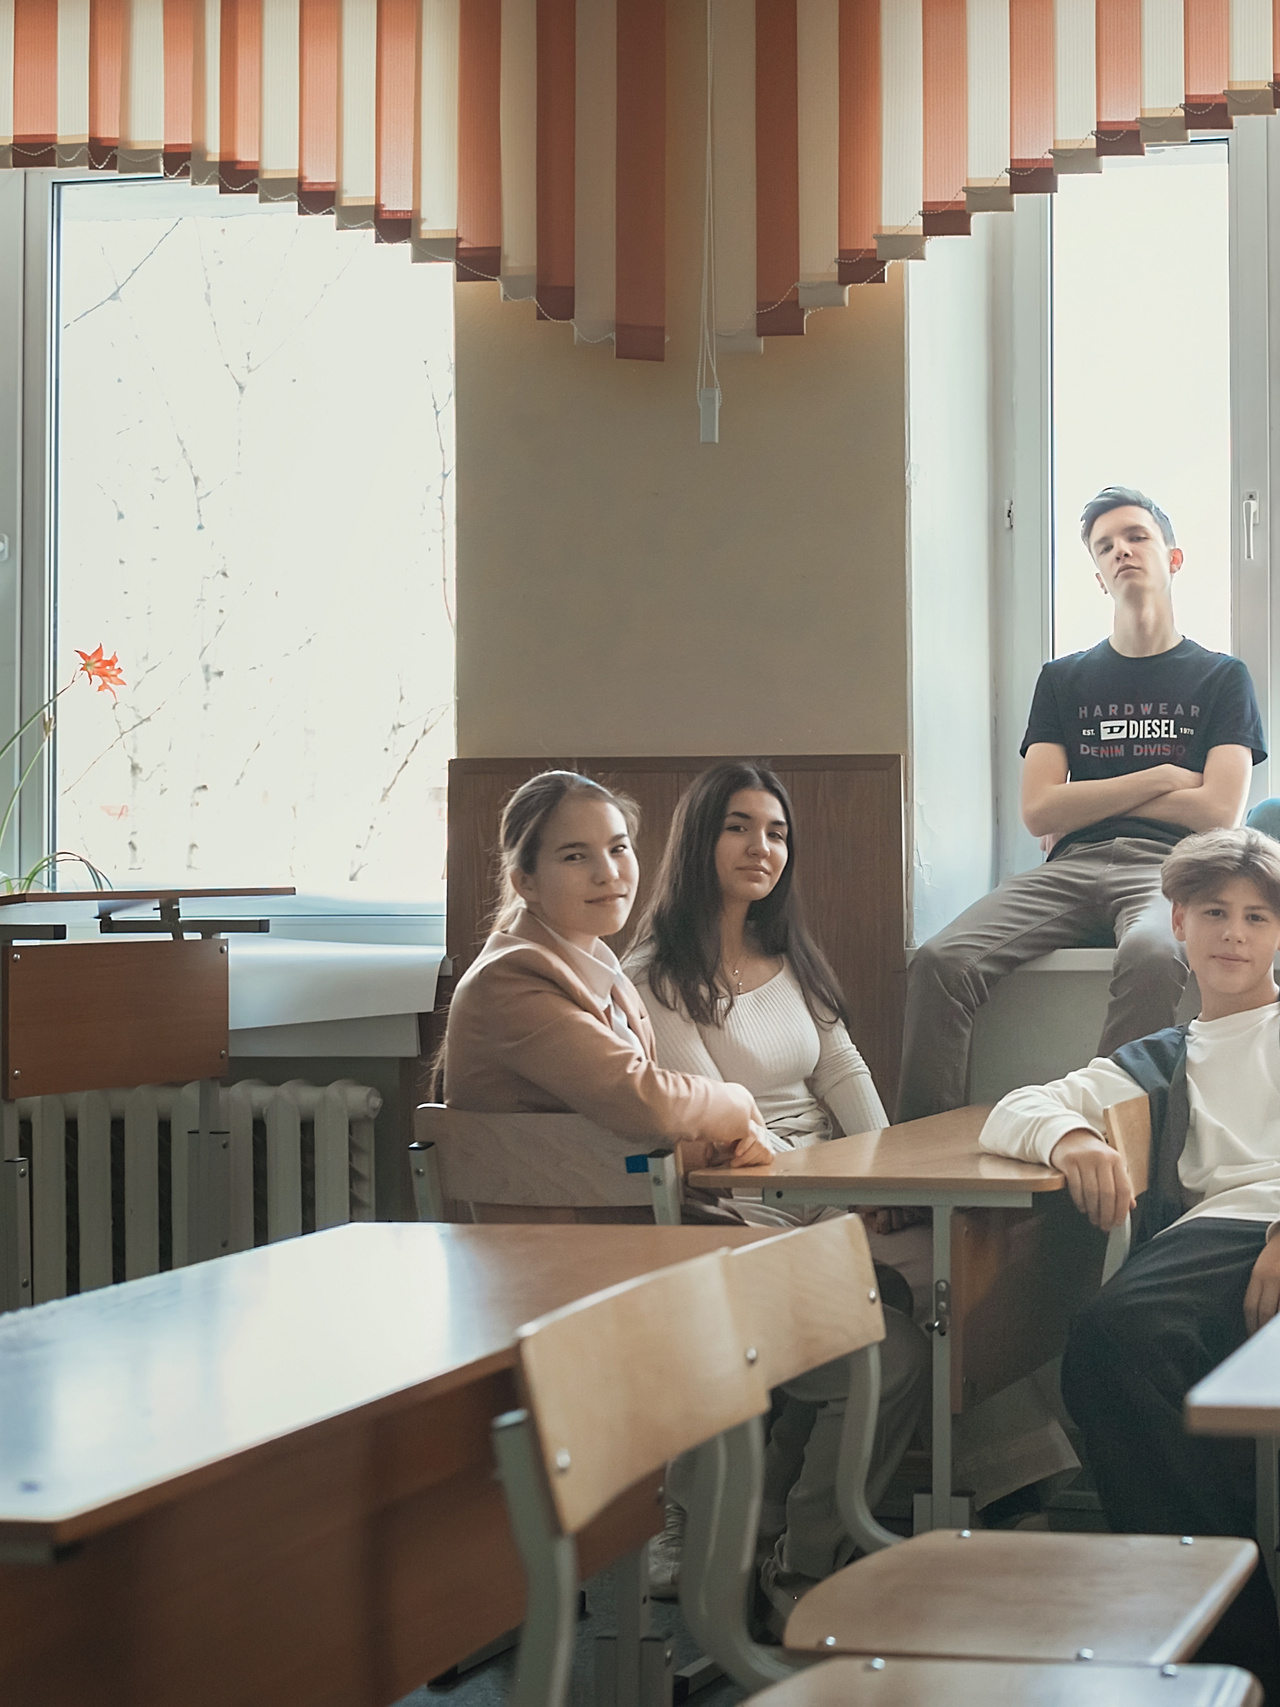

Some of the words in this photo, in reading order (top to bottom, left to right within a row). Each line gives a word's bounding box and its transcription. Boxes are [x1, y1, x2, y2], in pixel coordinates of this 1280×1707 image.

[1078, 703, 1200, 719] HARDWEAR
[1129, 720, 1177, 738] DIESEL
[1080, 744, 1125, 758] DENIM
